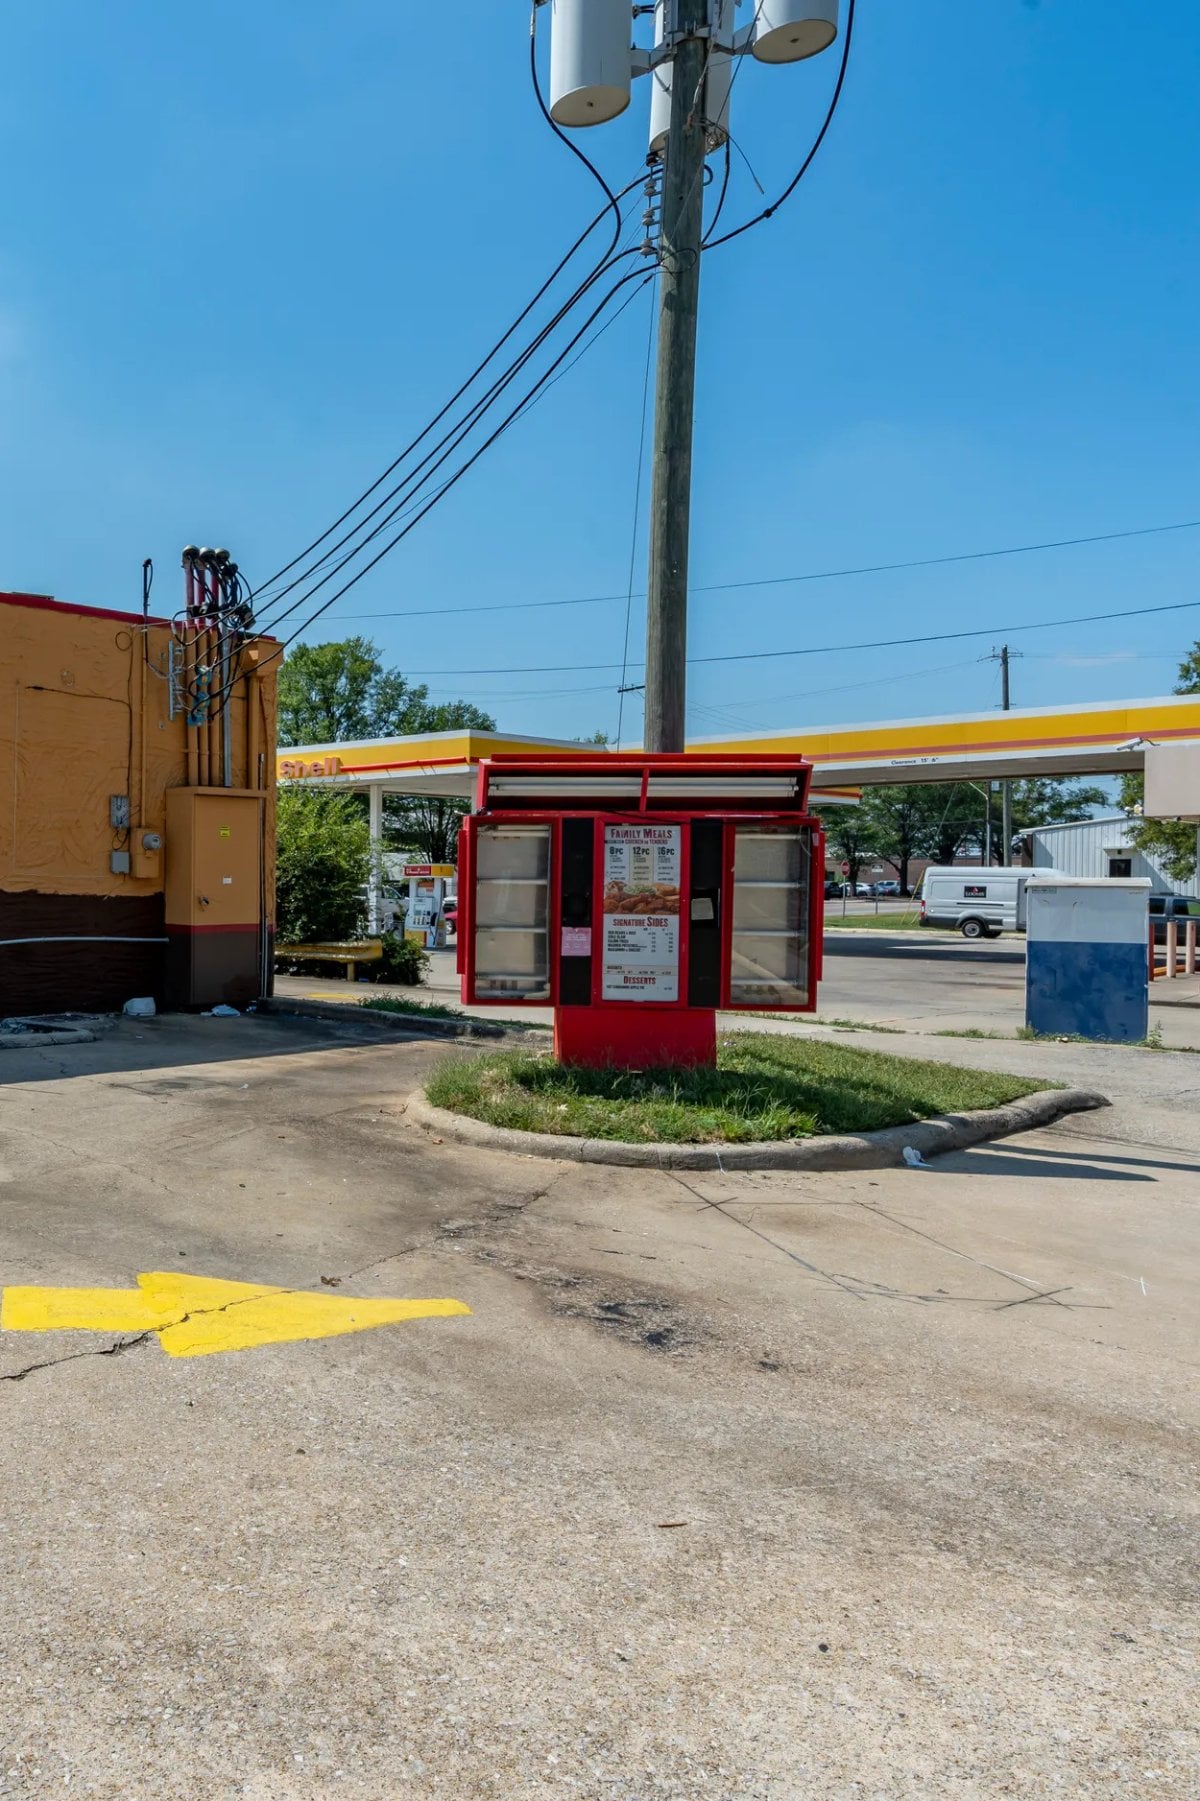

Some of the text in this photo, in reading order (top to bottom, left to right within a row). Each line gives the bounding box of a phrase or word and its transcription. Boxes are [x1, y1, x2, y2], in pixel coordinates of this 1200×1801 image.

[279, 756, 338, 778] Shell
[610, 828, 672, 839] FAMILY MEALS
[612, 916, 669, 928] SIGNATURE SIDES
[623, 975, 657, 985] DESSERTS
